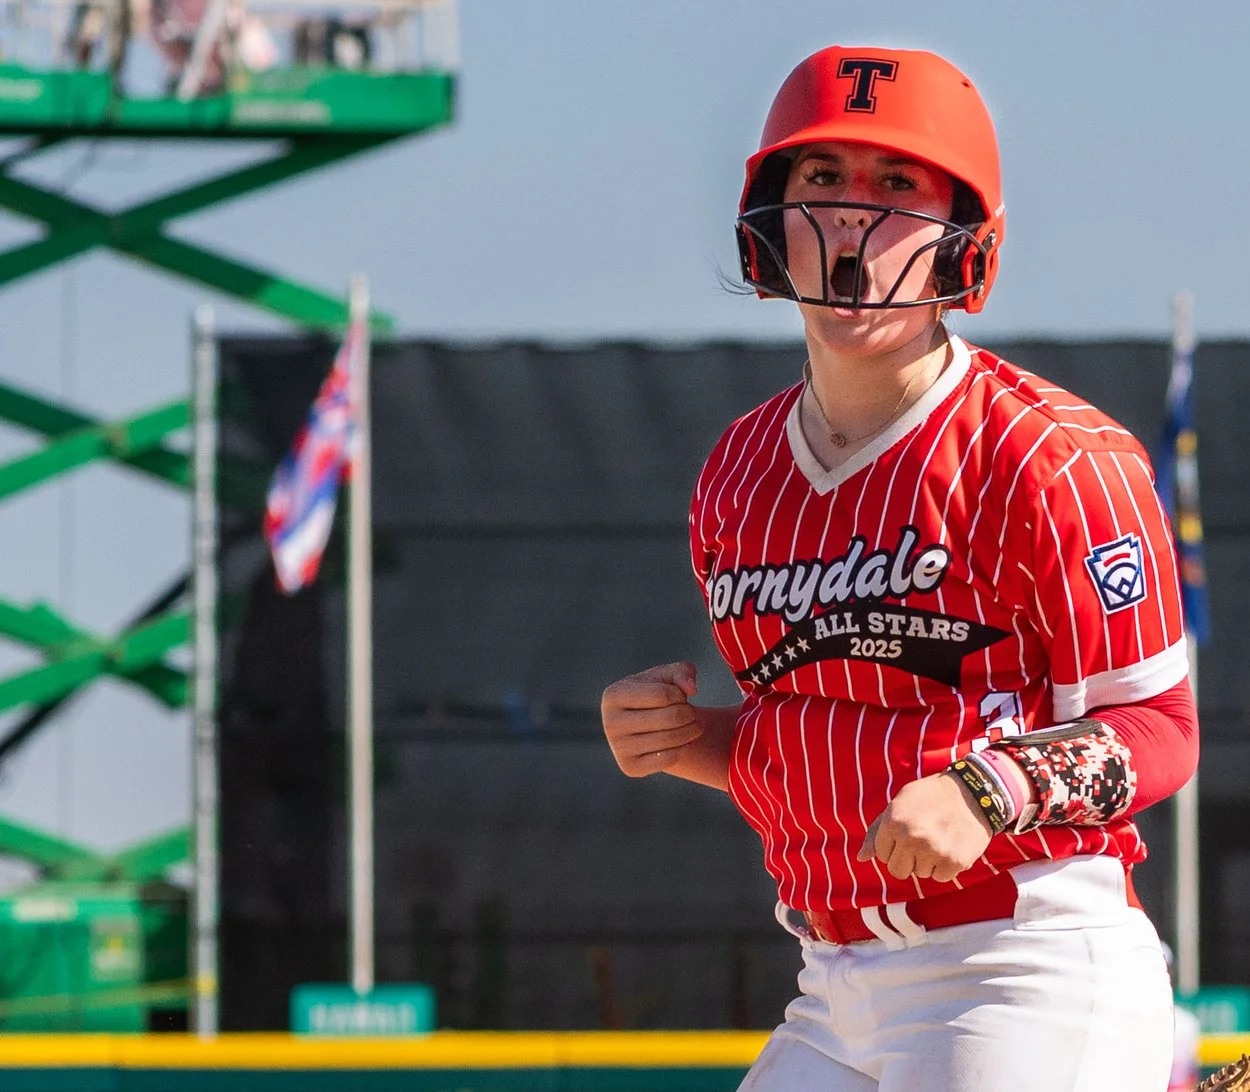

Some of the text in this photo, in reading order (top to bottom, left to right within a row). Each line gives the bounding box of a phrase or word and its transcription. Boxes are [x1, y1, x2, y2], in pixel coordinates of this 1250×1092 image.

[837, 57, 899, 114] T
[707, 530, 949, 623] ornydale
[815, 612, 970, 642] ALL STARS
[850, 637, 902, 658] 2025
